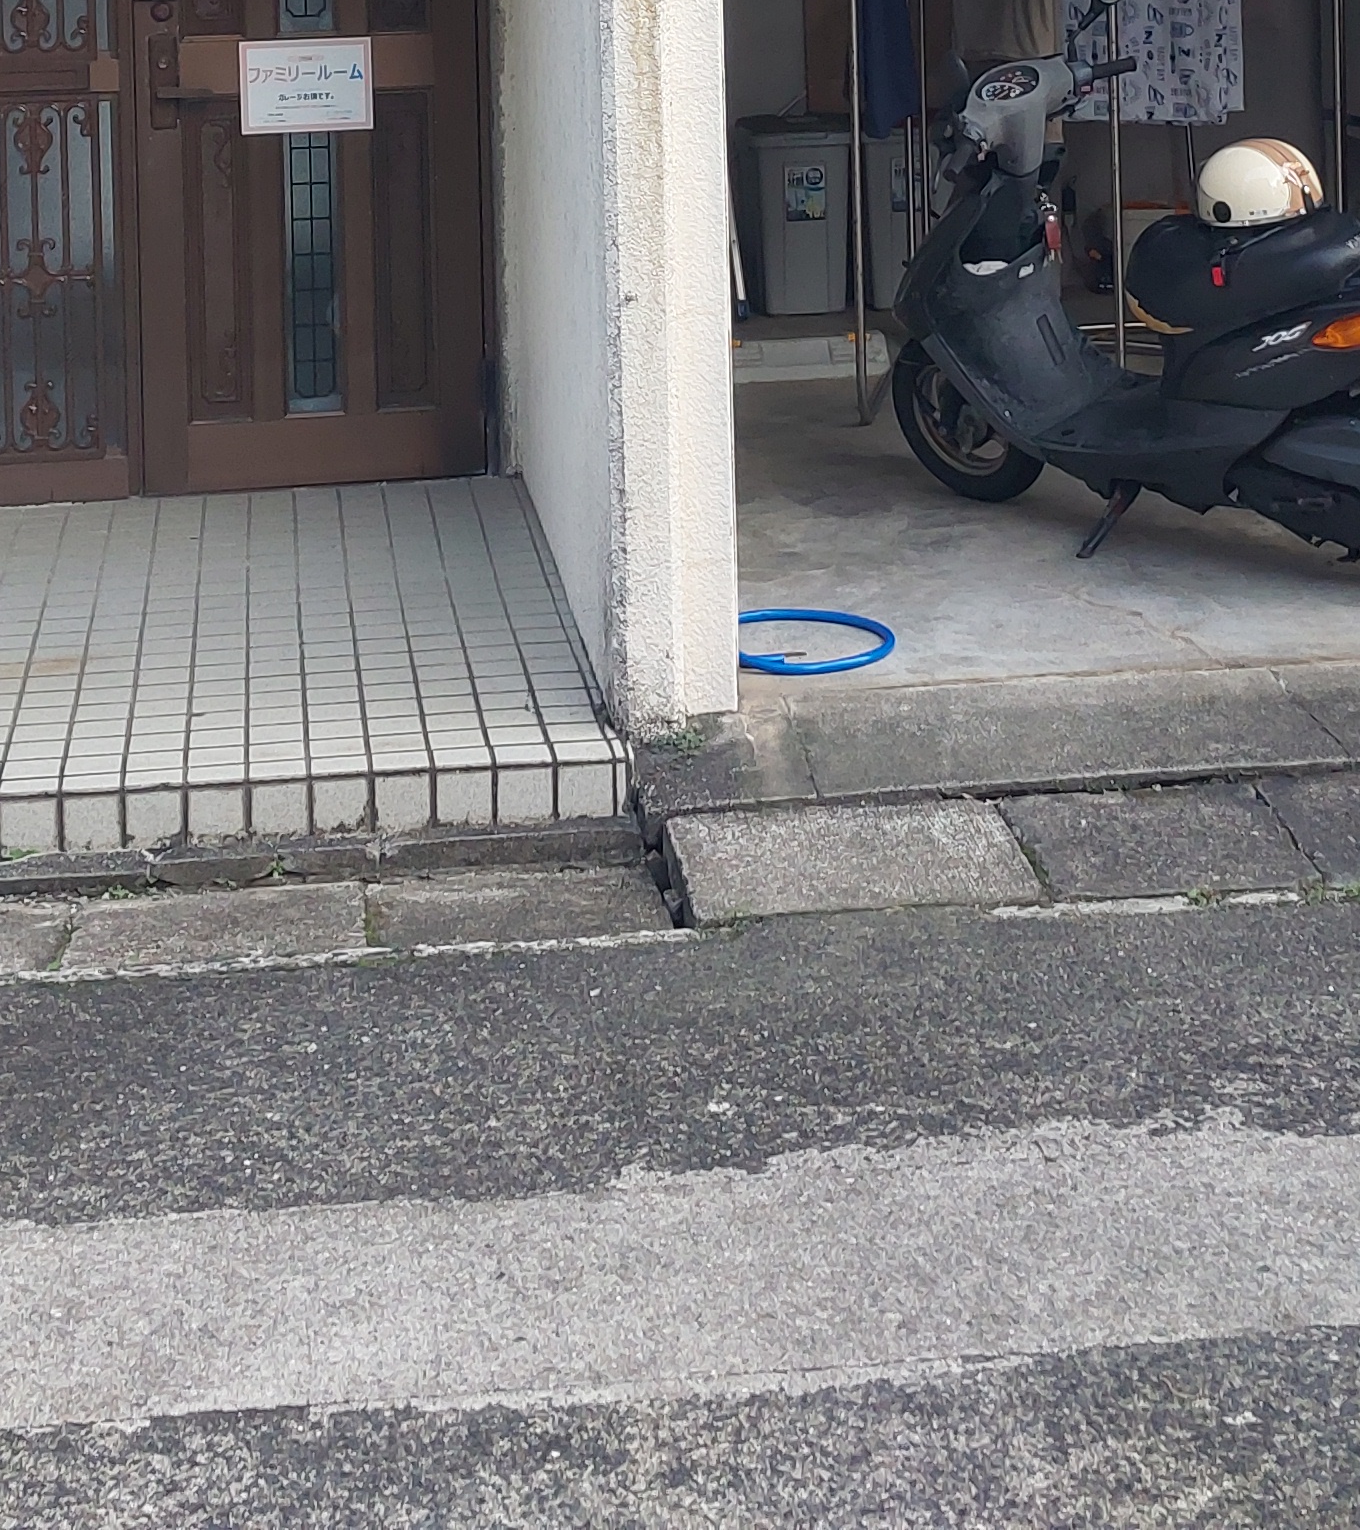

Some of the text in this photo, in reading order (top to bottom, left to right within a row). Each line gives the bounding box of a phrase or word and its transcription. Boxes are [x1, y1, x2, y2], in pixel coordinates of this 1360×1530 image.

[248, 63, 364, 83] ファミリールーム
